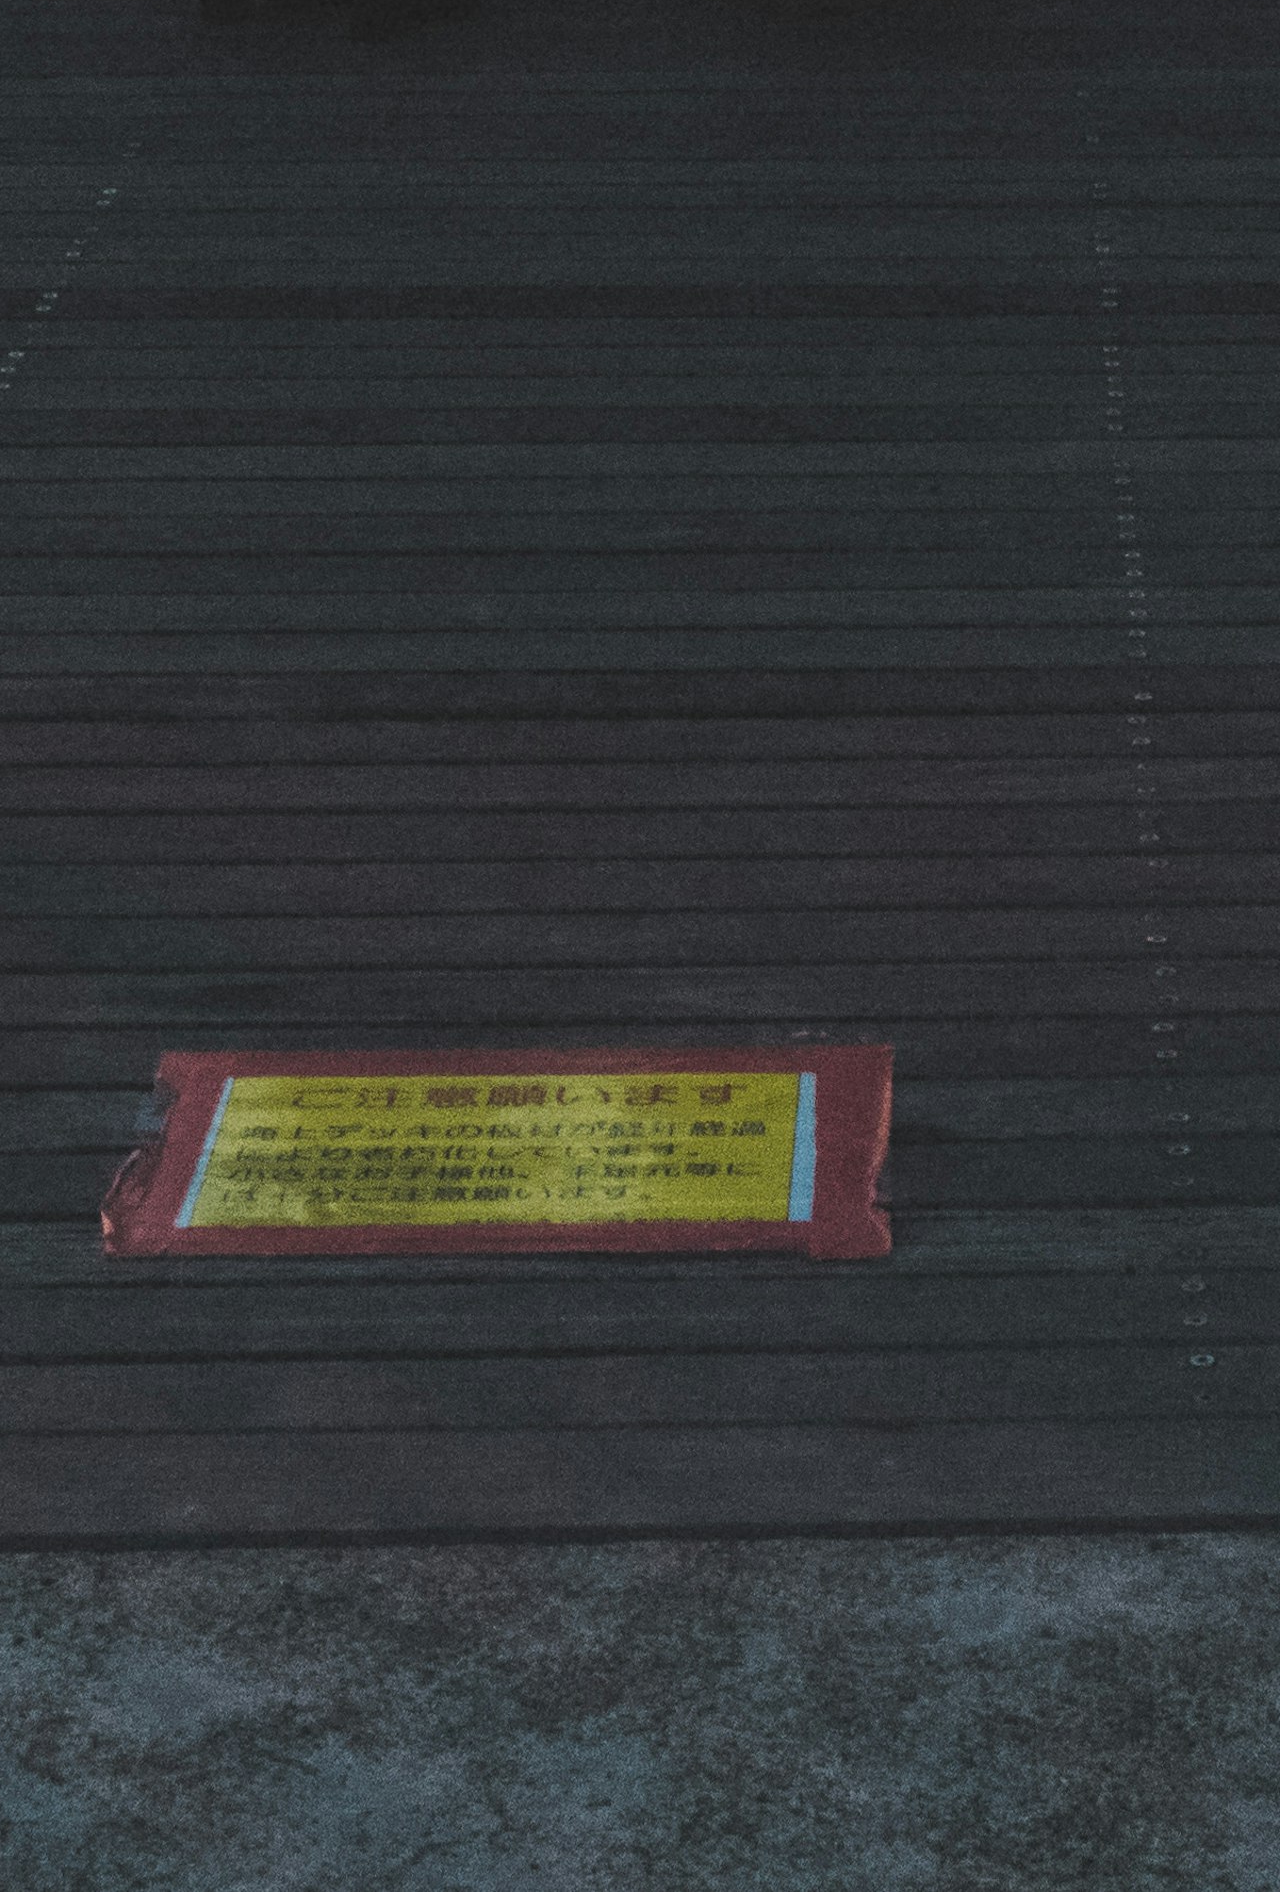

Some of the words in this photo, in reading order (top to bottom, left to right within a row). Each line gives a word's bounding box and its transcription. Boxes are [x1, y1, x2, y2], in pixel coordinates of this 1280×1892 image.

[291, 1084, 748, 1109] ご注意願います
